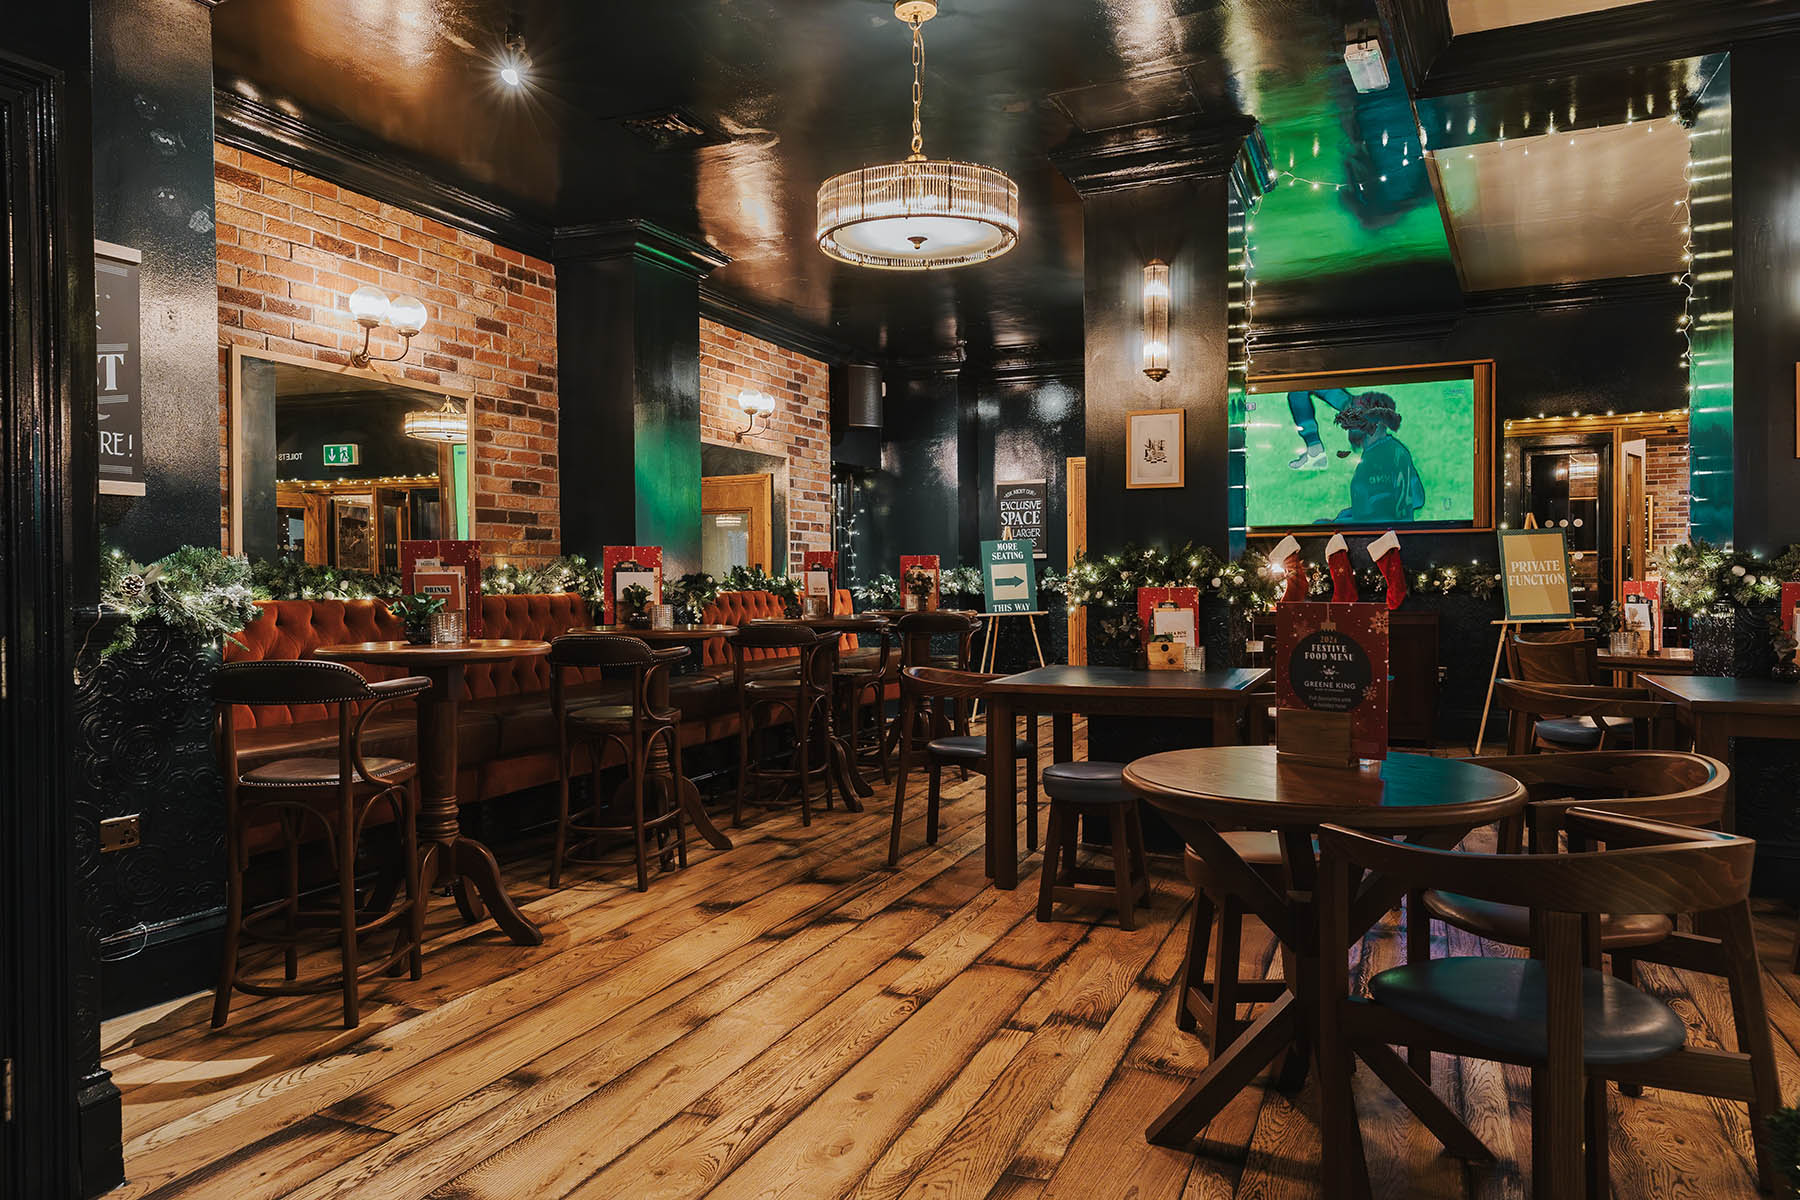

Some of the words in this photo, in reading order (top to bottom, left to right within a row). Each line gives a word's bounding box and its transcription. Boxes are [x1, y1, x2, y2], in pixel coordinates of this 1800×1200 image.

[1000, 500, 1041, 510] EXCLUSIVE
[1000, 511, 1040, 526] SPACE
[1012, 528, 1041, 538] LARGER
[997, 542, 1018, 551] MORE
[991, 551, 1024, 560] SEATING
[1511, 560, 1560, 573] PRIVATE
[1509, 573, 1565, 586] FUNCTION
[993, 604, 1013, 613] THIS
[1014, 603, 1031, 611] WAY
[1311, 644, 1347, 653] FESTIVE
[1304, 651, 1328, 660] FOOD
[1330, 652, 1353, 661] MENU
[1304, 680, 1334, 688] GREENE
[1335, 682, 1356, 690] KING
